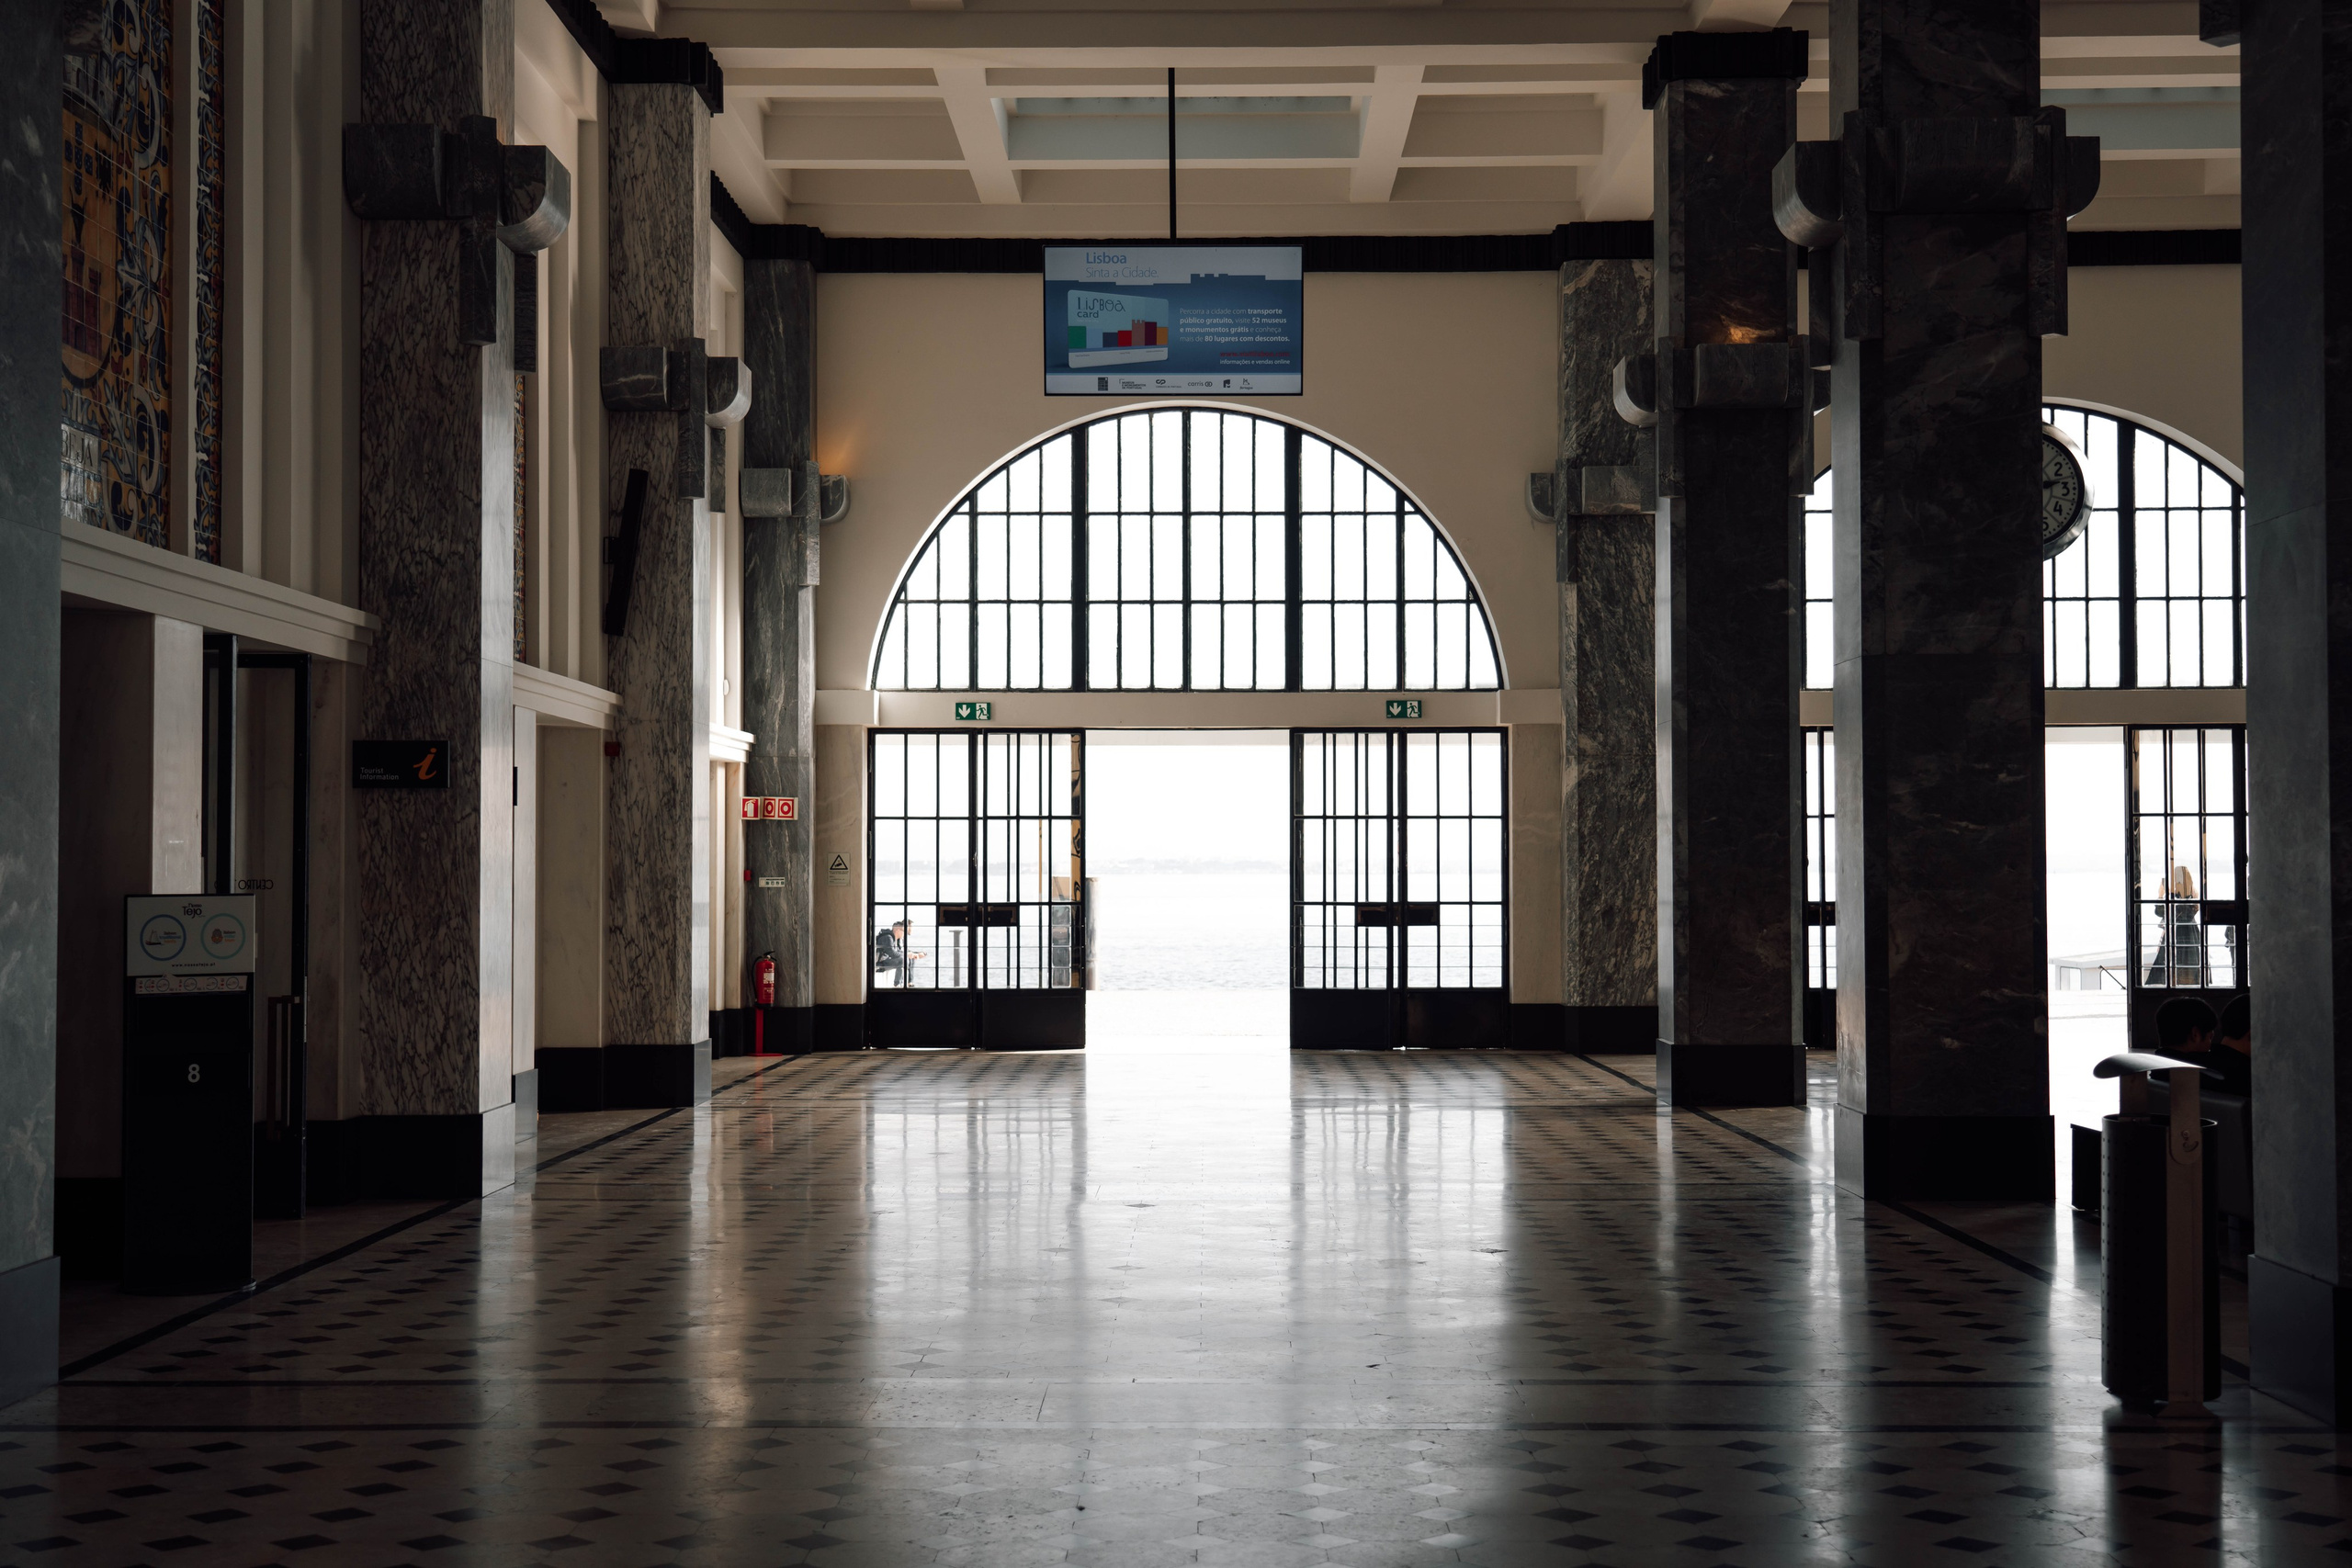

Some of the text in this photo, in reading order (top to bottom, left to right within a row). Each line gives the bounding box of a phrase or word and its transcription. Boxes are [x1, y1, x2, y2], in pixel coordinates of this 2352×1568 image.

[1086, 252, 1127, 264] Lisboa
[1086, 266, 1159, 278] Sinta a Cidade.
[1077, 310, 1099, 318] card
[1248, 309, 1283, 317] transporte
[61, 429, 93, 467] BEJA
[2054, 462, 2063, 477] 2
[2061, 481, 2070, 496] 3
[2053, 501, 2063, 516] 4
[2042, 517, 2049, 531] 5
[182, 905, 202, 919] Tejo
[187, 1064, 201, 1083] 8
